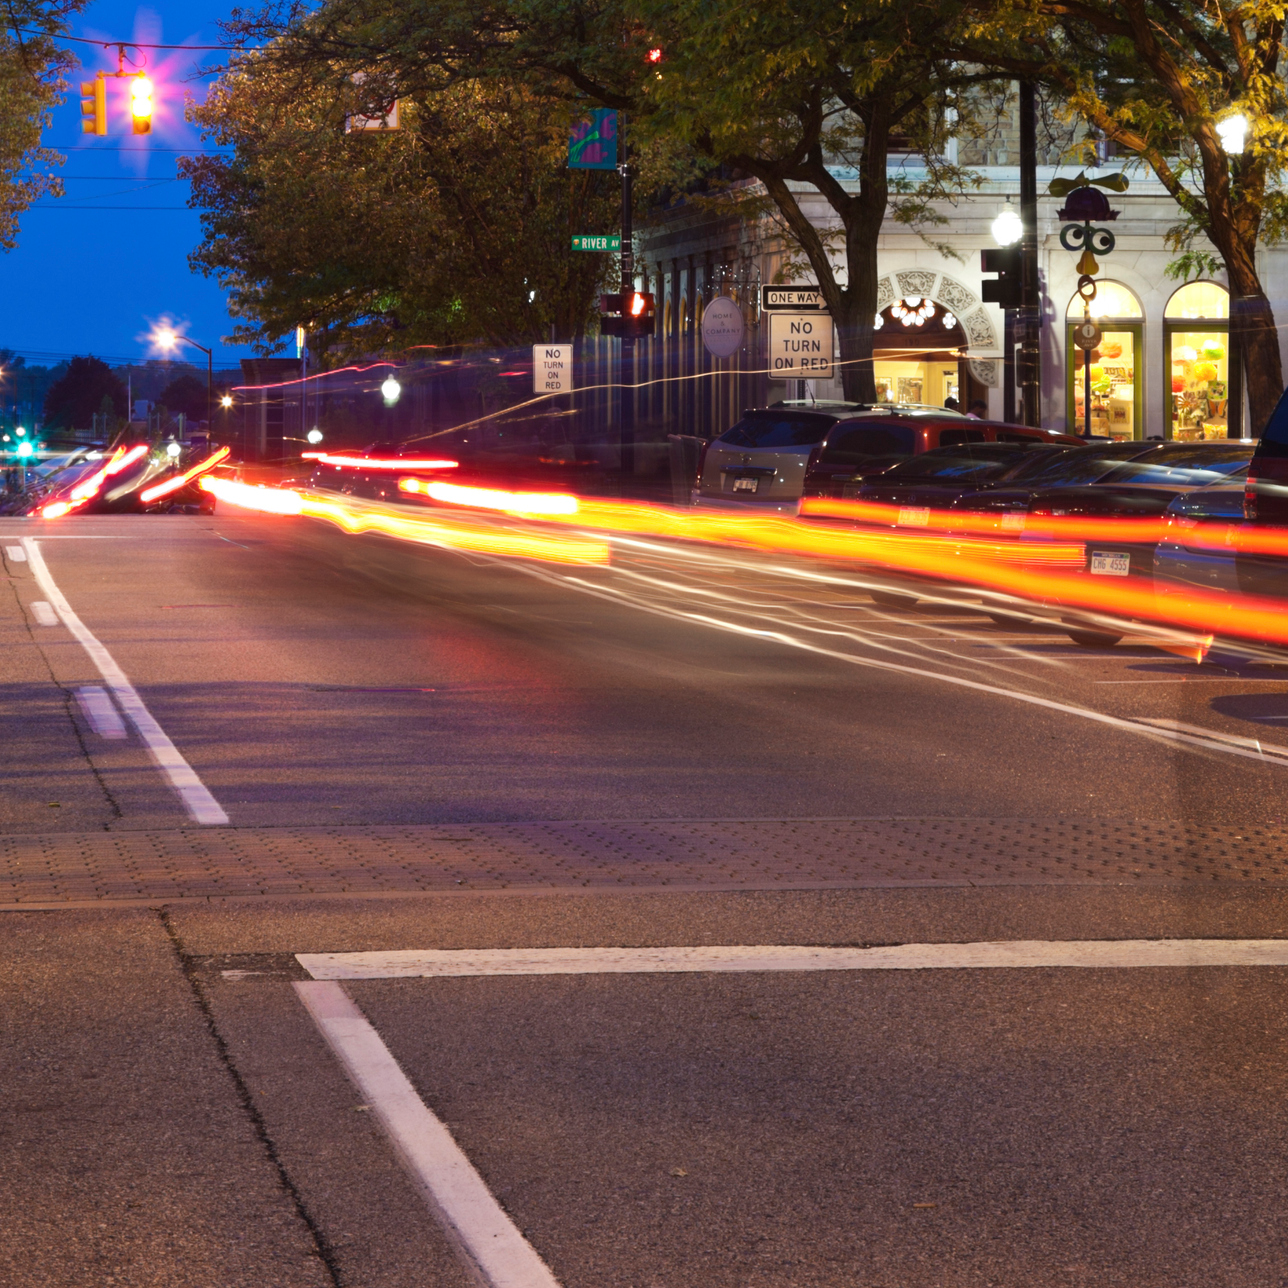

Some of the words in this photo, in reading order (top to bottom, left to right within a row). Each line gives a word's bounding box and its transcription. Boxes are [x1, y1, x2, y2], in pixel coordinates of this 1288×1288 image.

[581, 237, 607, 249] RIVER
[611, 239, 620, 248] AV
[770, 292, 794, 303] ONE
[797, 292, 820, 303] WAY
[790, 321, 813, 334] NO
[783, 339, 821, 352] TURN
[545, 349, 561, 359] NO
[543, 361, 564, 369] TURN
[774, 357, 794, 370] ON
[800, 357, 829, 370] RED
[547, 371, 559, 380] ON
[545, 381, 561, 390] RED
[1109, 558, 1128, 571] 4555
